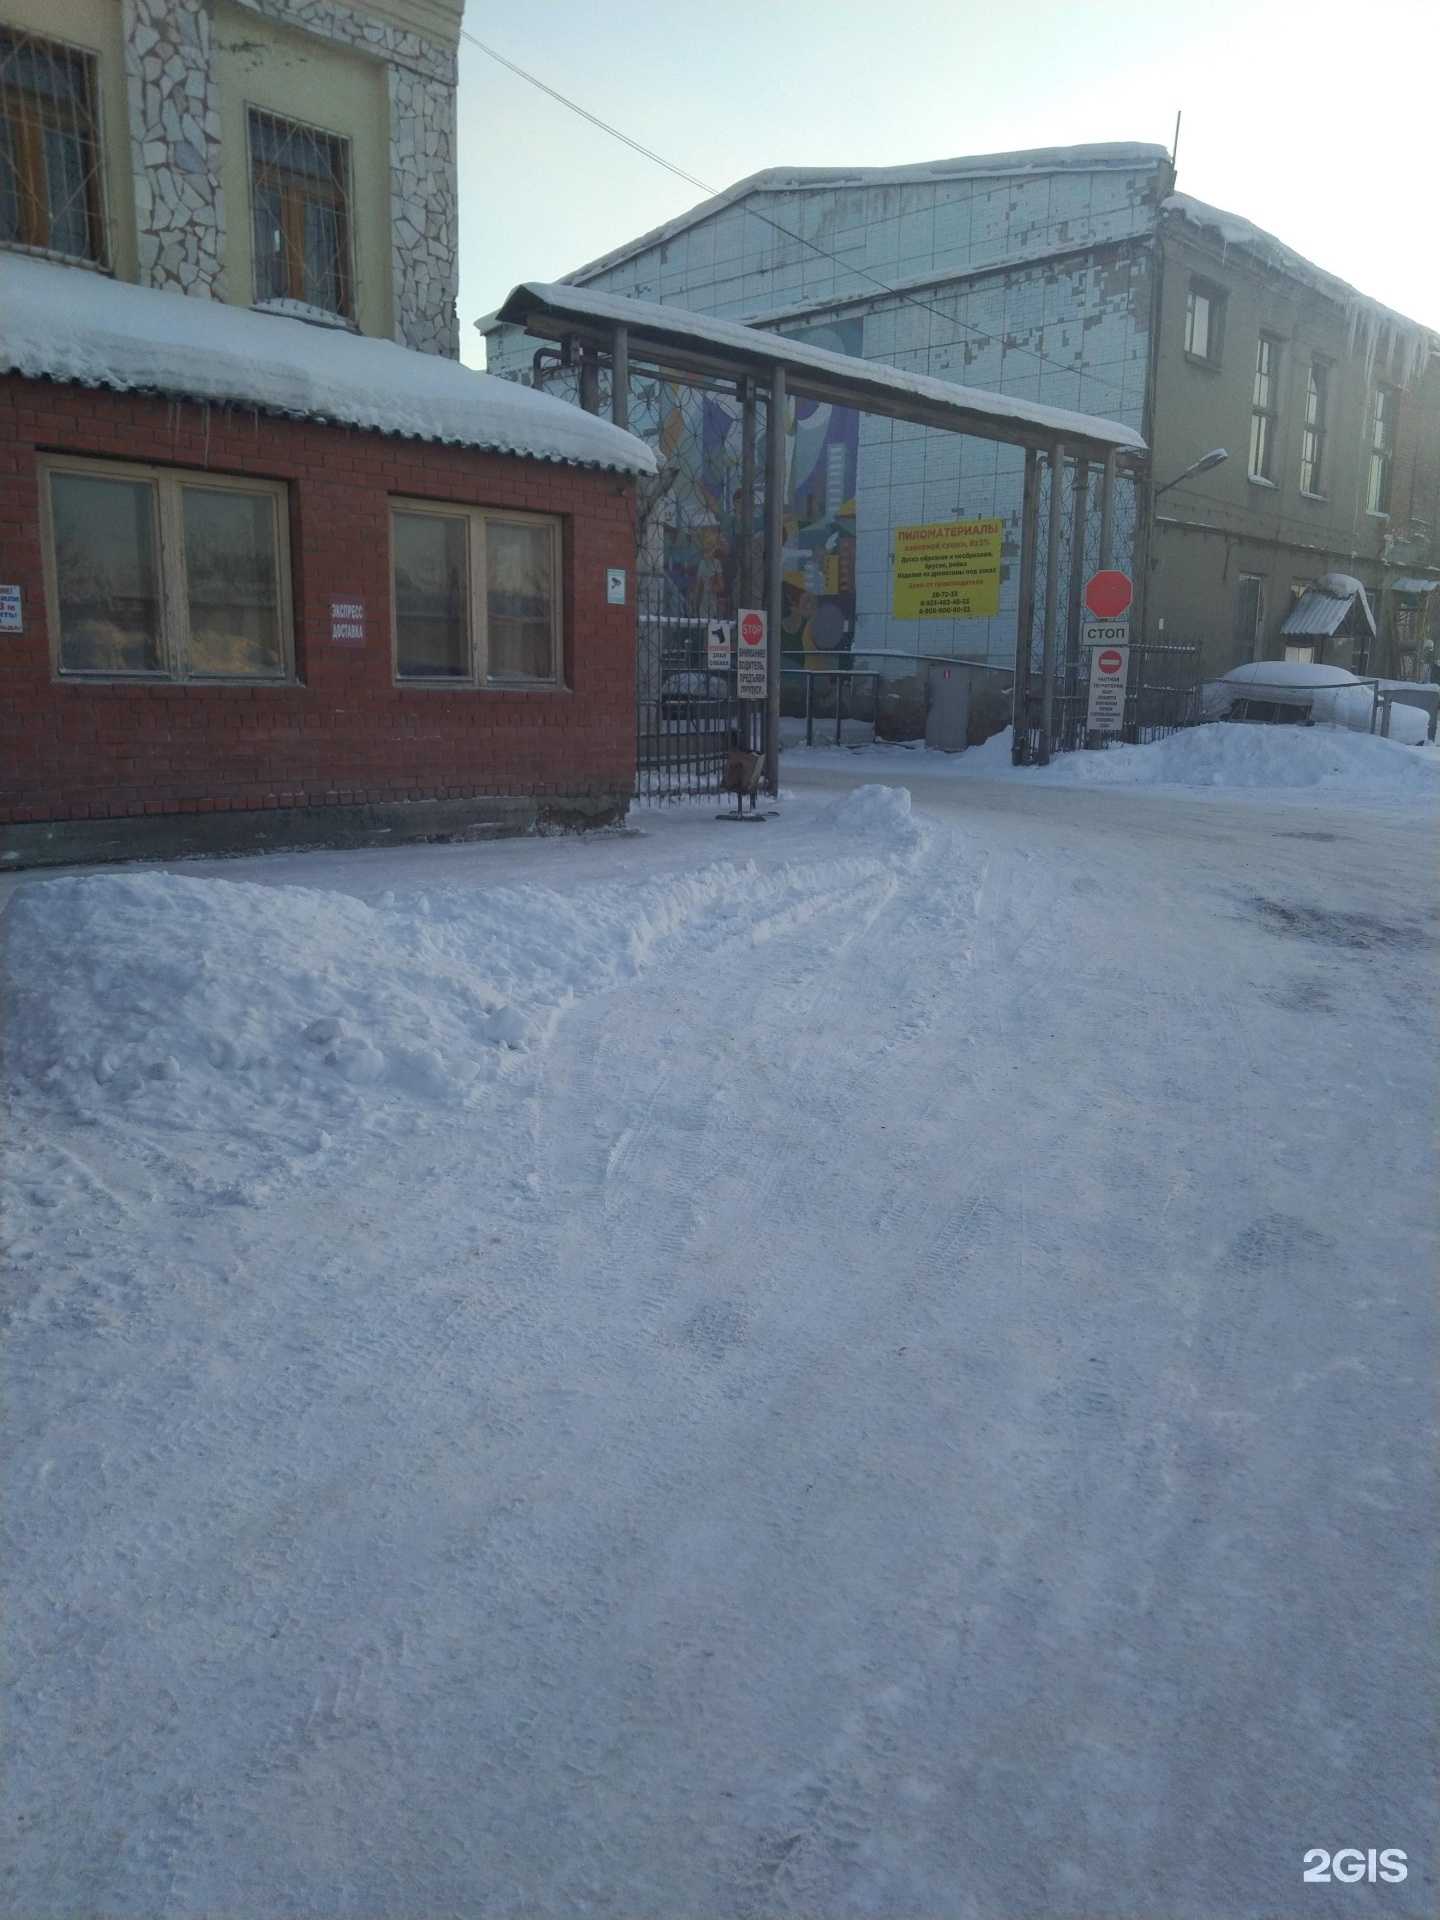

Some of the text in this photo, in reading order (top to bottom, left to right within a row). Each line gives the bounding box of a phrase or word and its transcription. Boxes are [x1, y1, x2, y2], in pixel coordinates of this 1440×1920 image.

[898, 524, 998, 540] ПИЛОМАТЕРИАЛЫ
[331, 604, 362, 618] ЭКСПРЕСС
[332, 624, 363, 640] ДОСТАВКА
[742, 625, 762, 635] STOP
[1088, 629, 1125, 639] СТОП
